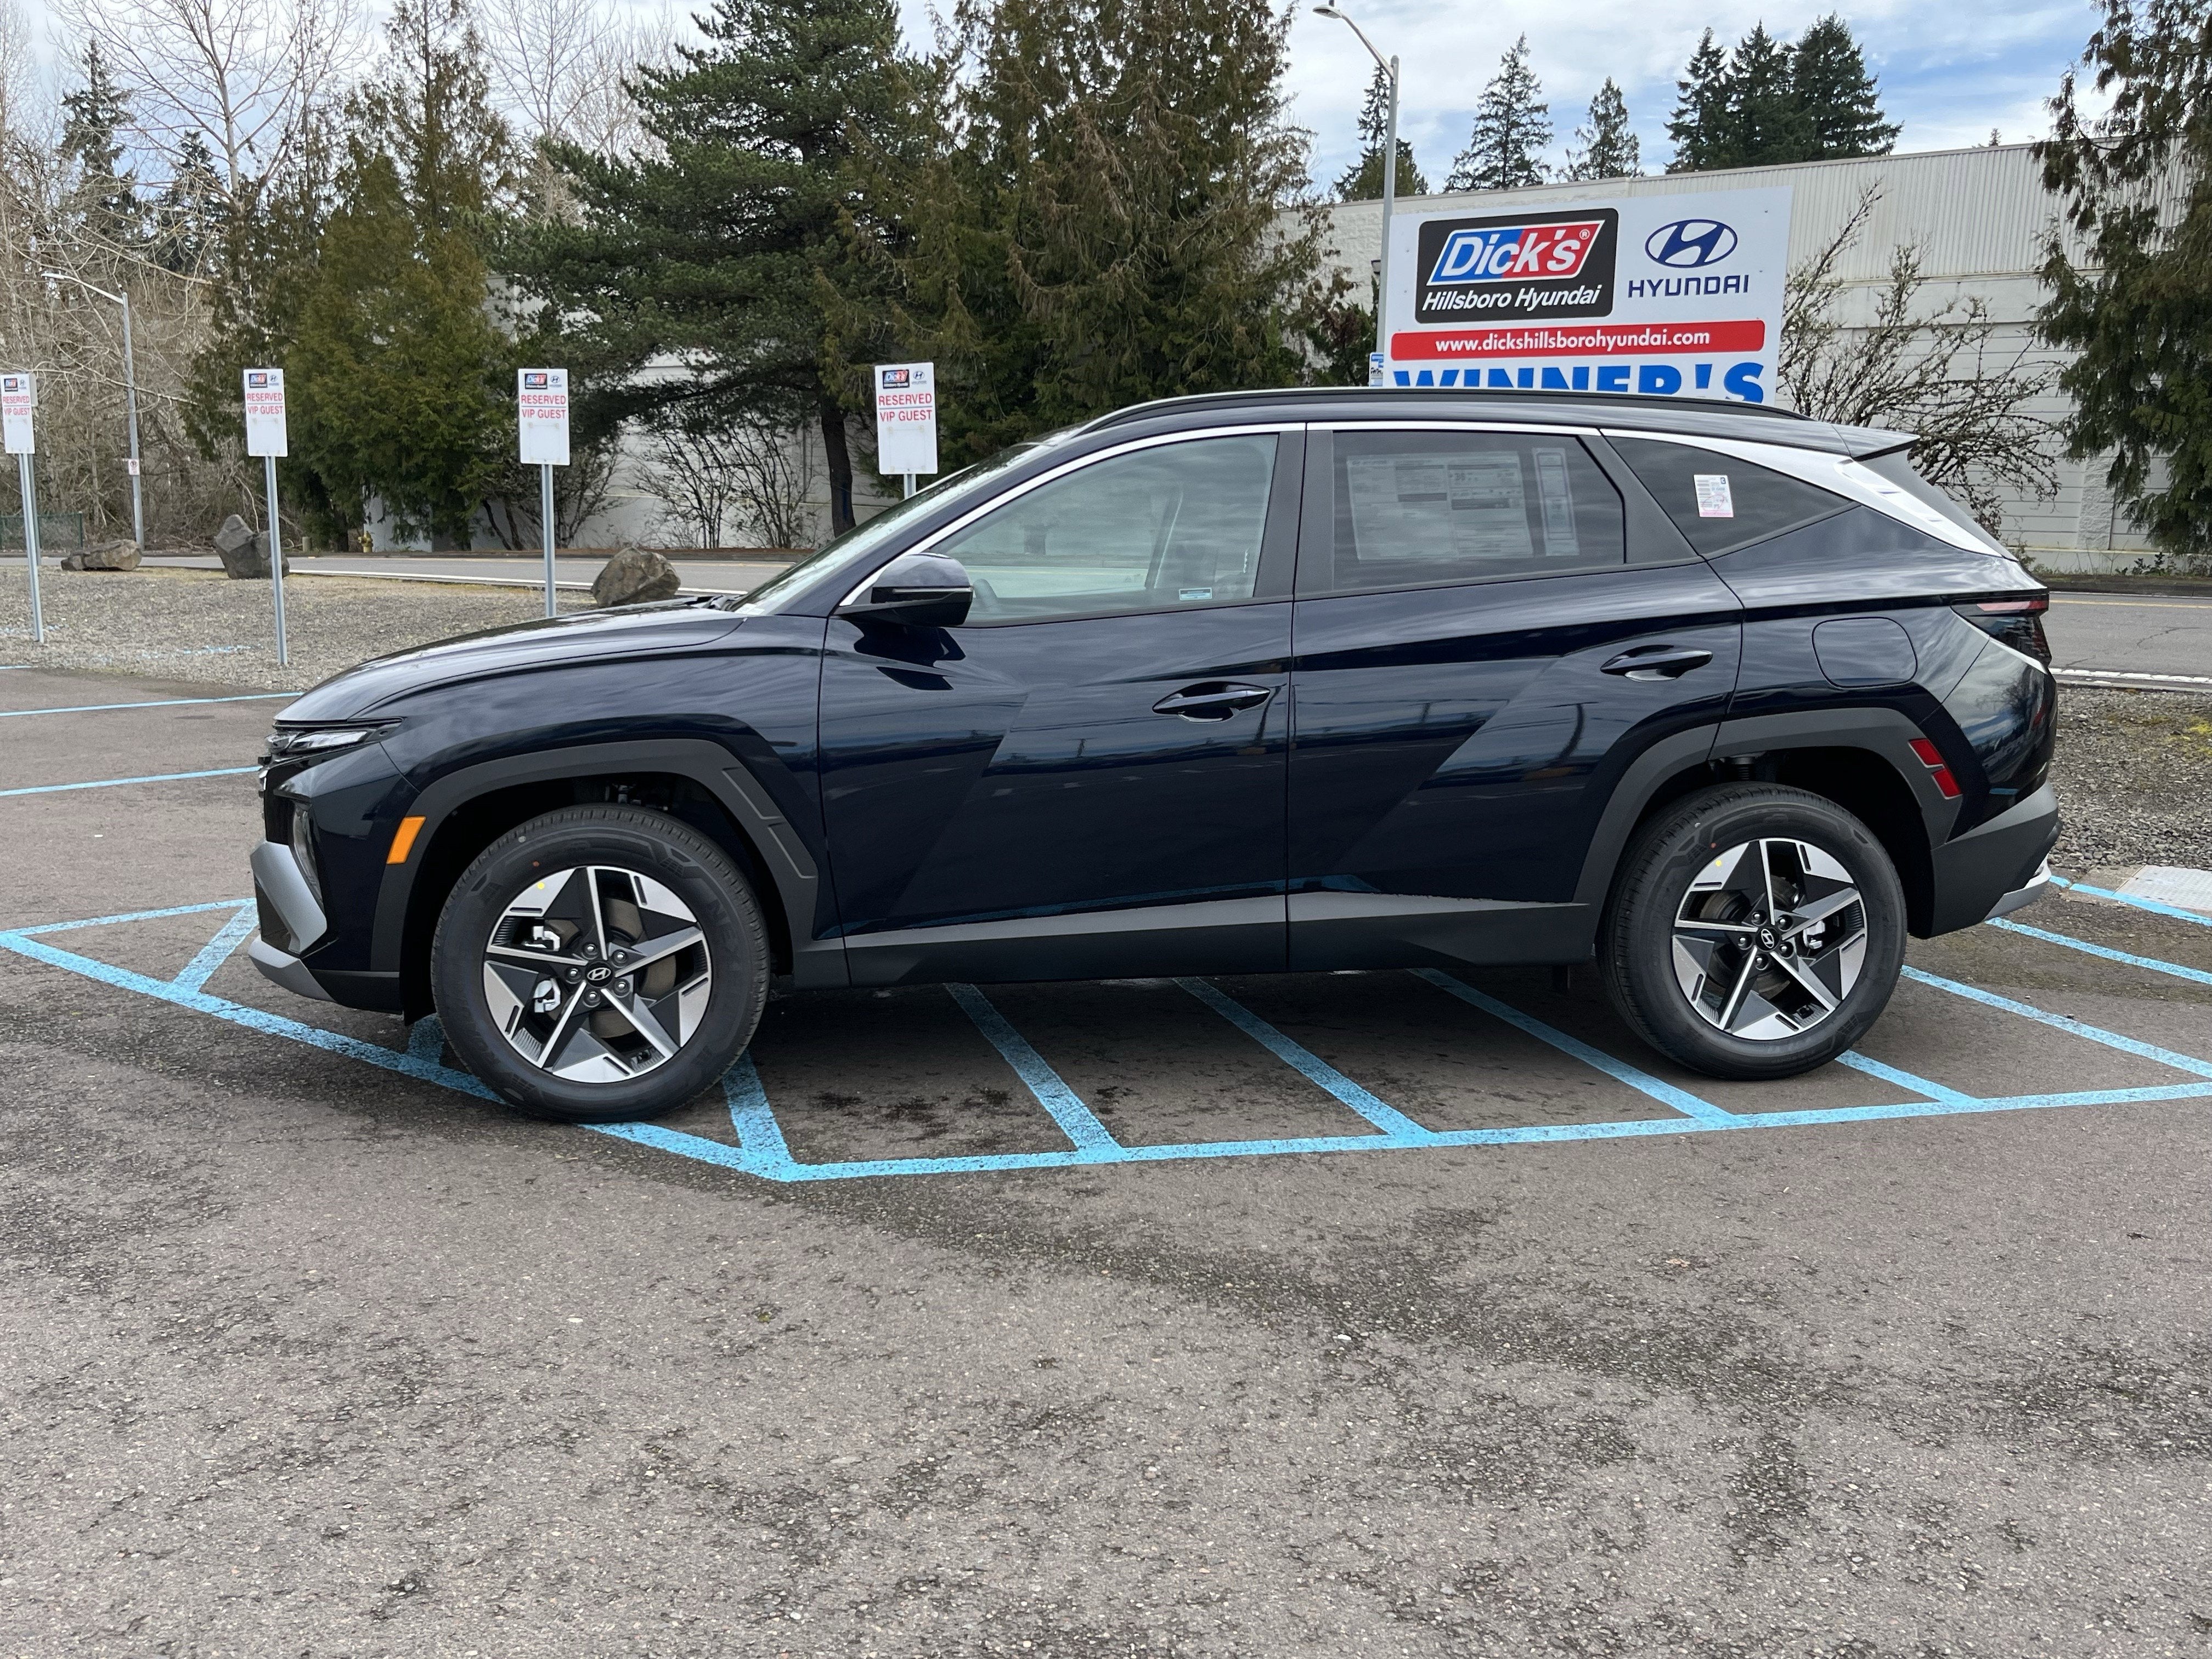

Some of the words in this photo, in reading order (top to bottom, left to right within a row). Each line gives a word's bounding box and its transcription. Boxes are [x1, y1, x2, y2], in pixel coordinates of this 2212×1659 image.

[1628, 274, 1749, 298] HYUNDAI
[1422, 290, 1512, 311] Hillsboro
[1514, 284, 1603, 312] Hyundai
[1435, 328, 1710, 352] www.dickshillsborohyundai.com
[2, 396, 30, 404] RESERVED
[246, 393, 283, 402] RESERVED
[521, 394, 566, 404] RESERVED
[878, 393, 932, 405] RESERVED
[13, 407, 30, 415] GUEST
[247, 406, 258, 414] VIP
[260, 406, 283, 414] GUEST
[522, 409, 535, 418] VIP
[538, 409, 566, 419] GUEST
[879, 411, 895, 422] VIP
[899, 410, 933, 421] GUEST
